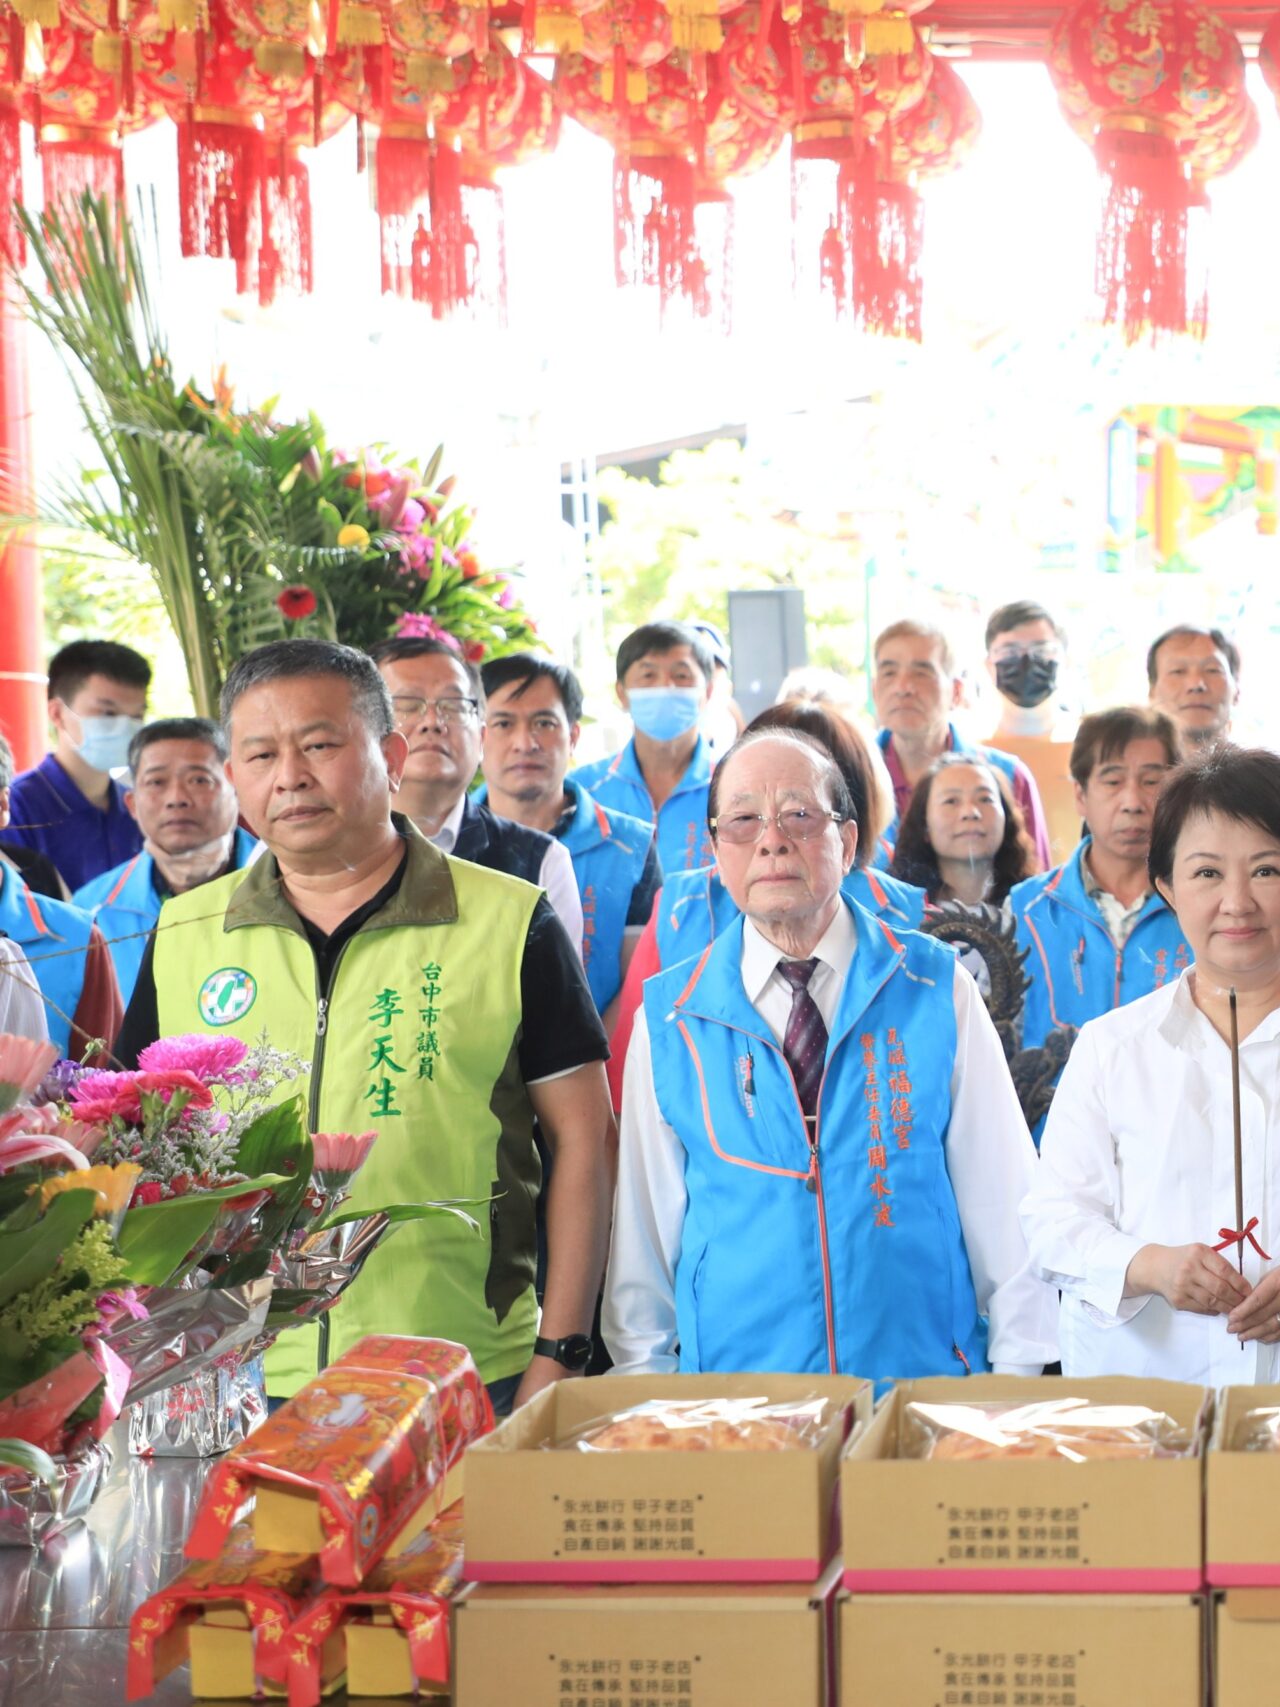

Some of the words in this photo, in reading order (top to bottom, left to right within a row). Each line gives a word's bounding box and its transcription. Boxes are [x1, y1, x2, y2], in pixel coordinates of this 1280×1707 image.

[364, 988, 407, 1118] 李天生
[416, 962, 442, 1081] 台中市議員
[633, 1500, 694, 1513] 甲子老店
